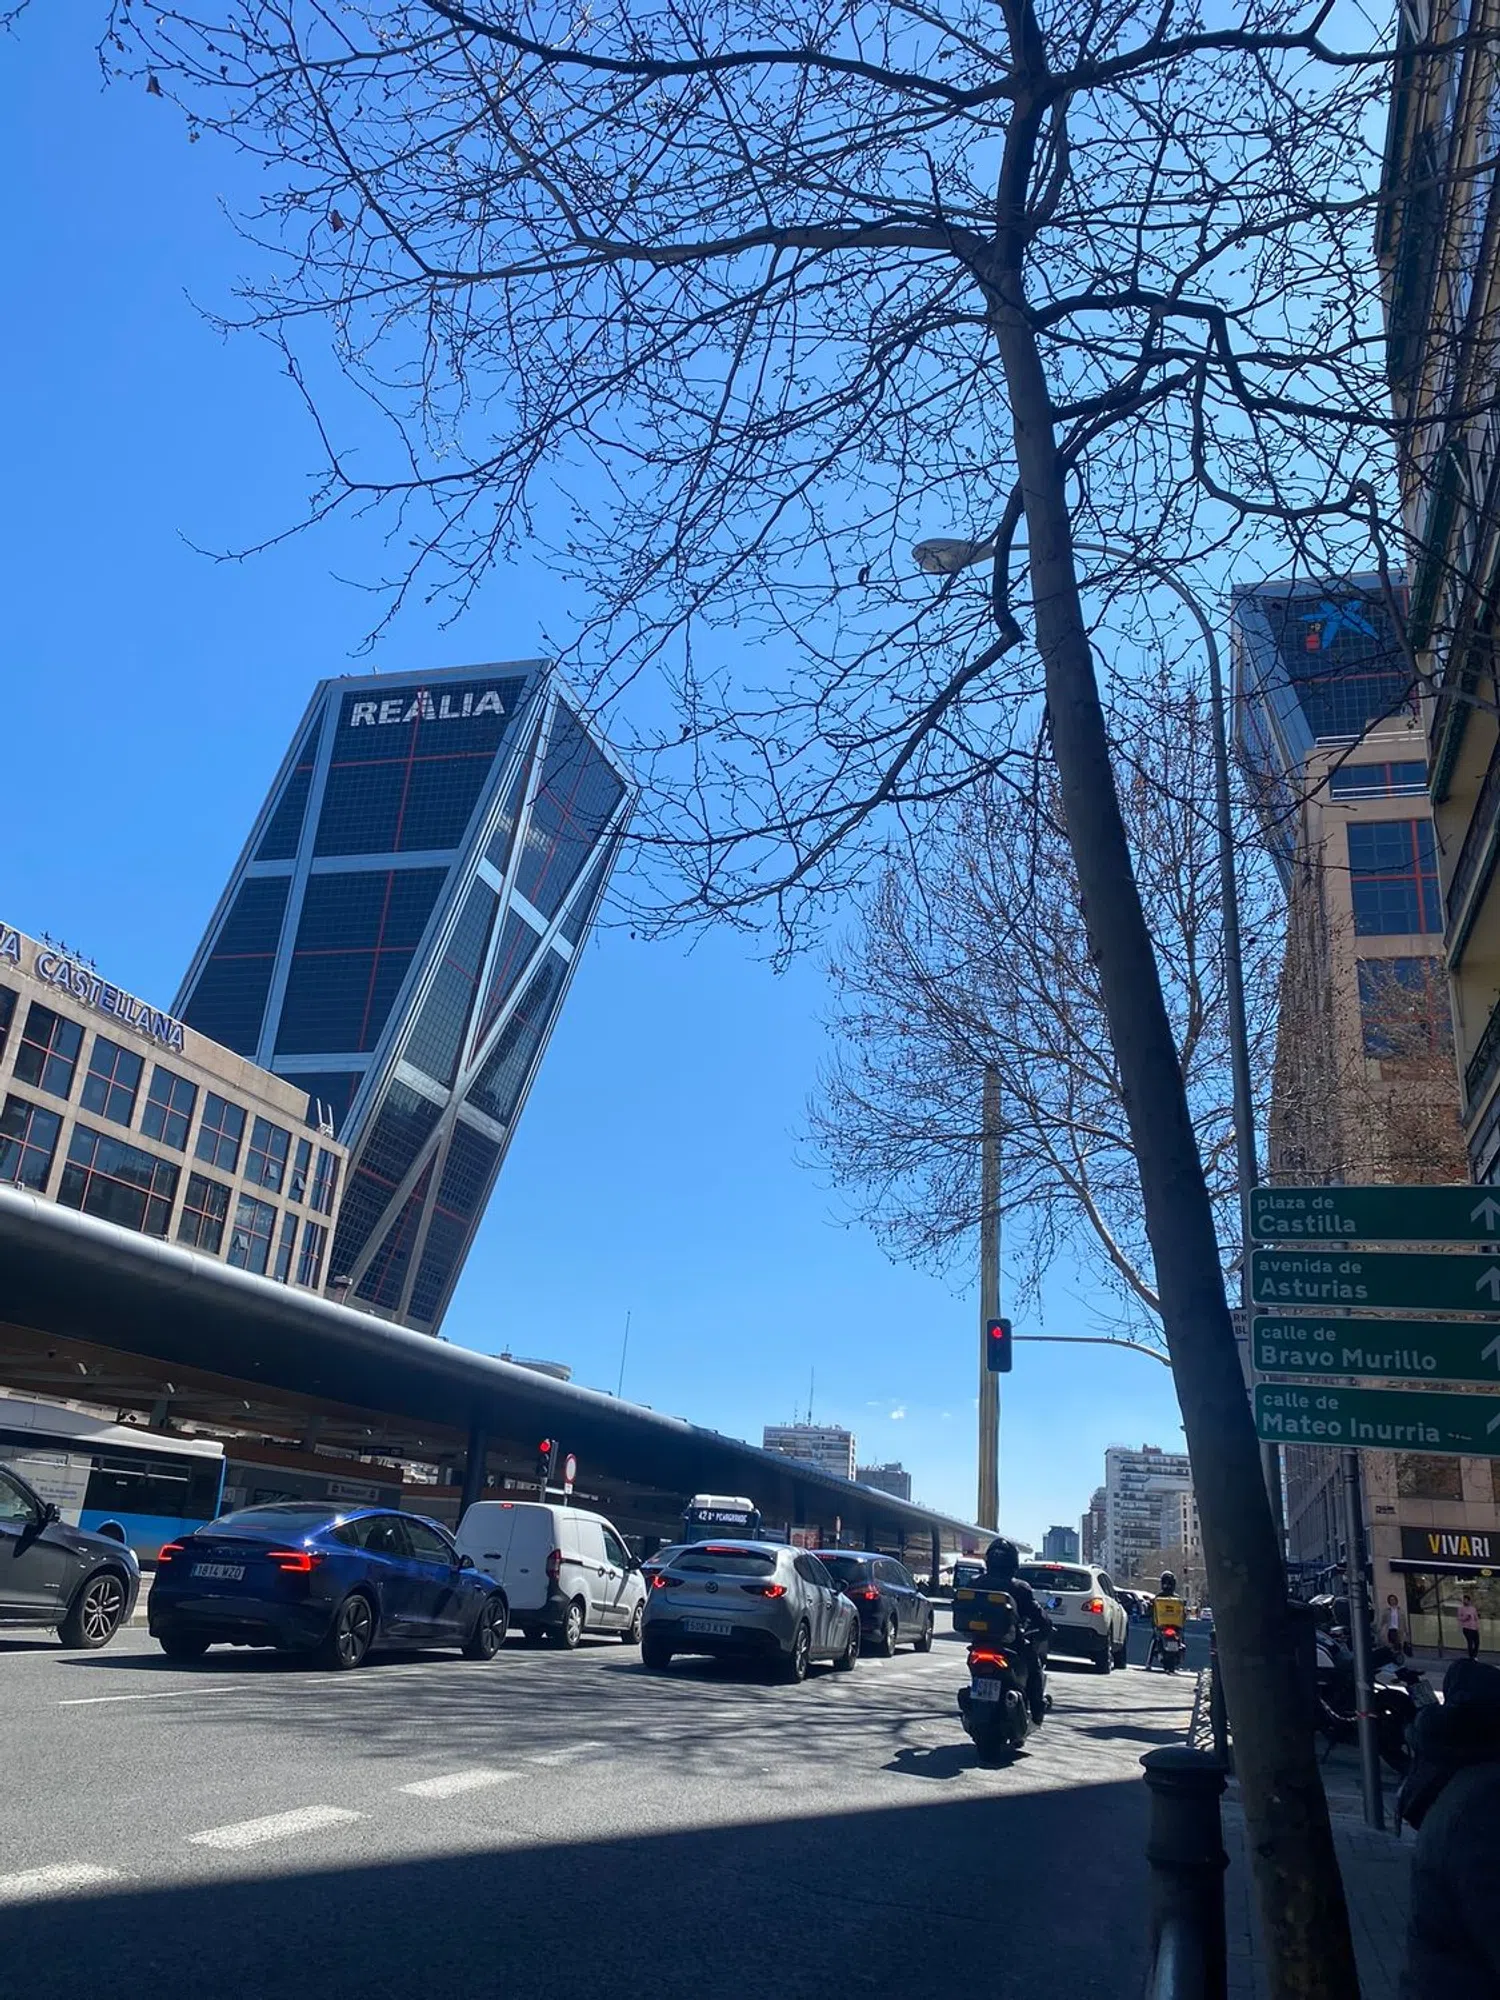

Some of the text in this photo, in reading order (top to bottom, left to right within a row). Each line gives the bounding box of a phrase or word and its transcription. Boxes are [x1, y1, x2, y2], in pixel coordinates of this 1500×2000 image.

[351, 691, 505, 727] REALIA
[35, 952, 185, 1052] CASTELLANA
[1258, 1196, 1334, 1212] plaza de
[1258, 1215, 1357, 1233] Castilla
[1259, 1259, 1362, 1274] avenida de
[1260, 1278, 1368, 1299] Asturias
[1261, 1326, 1337, 1341] calle de
[1261, 1346, 1437, 1370] Bravo Murillo
[1262, 1392, 1339, 1410] calle de
[1262, 1412, 1440, 1443] Mateo Inurria
[1428, 1533, 1491, 1557] VIVARI
